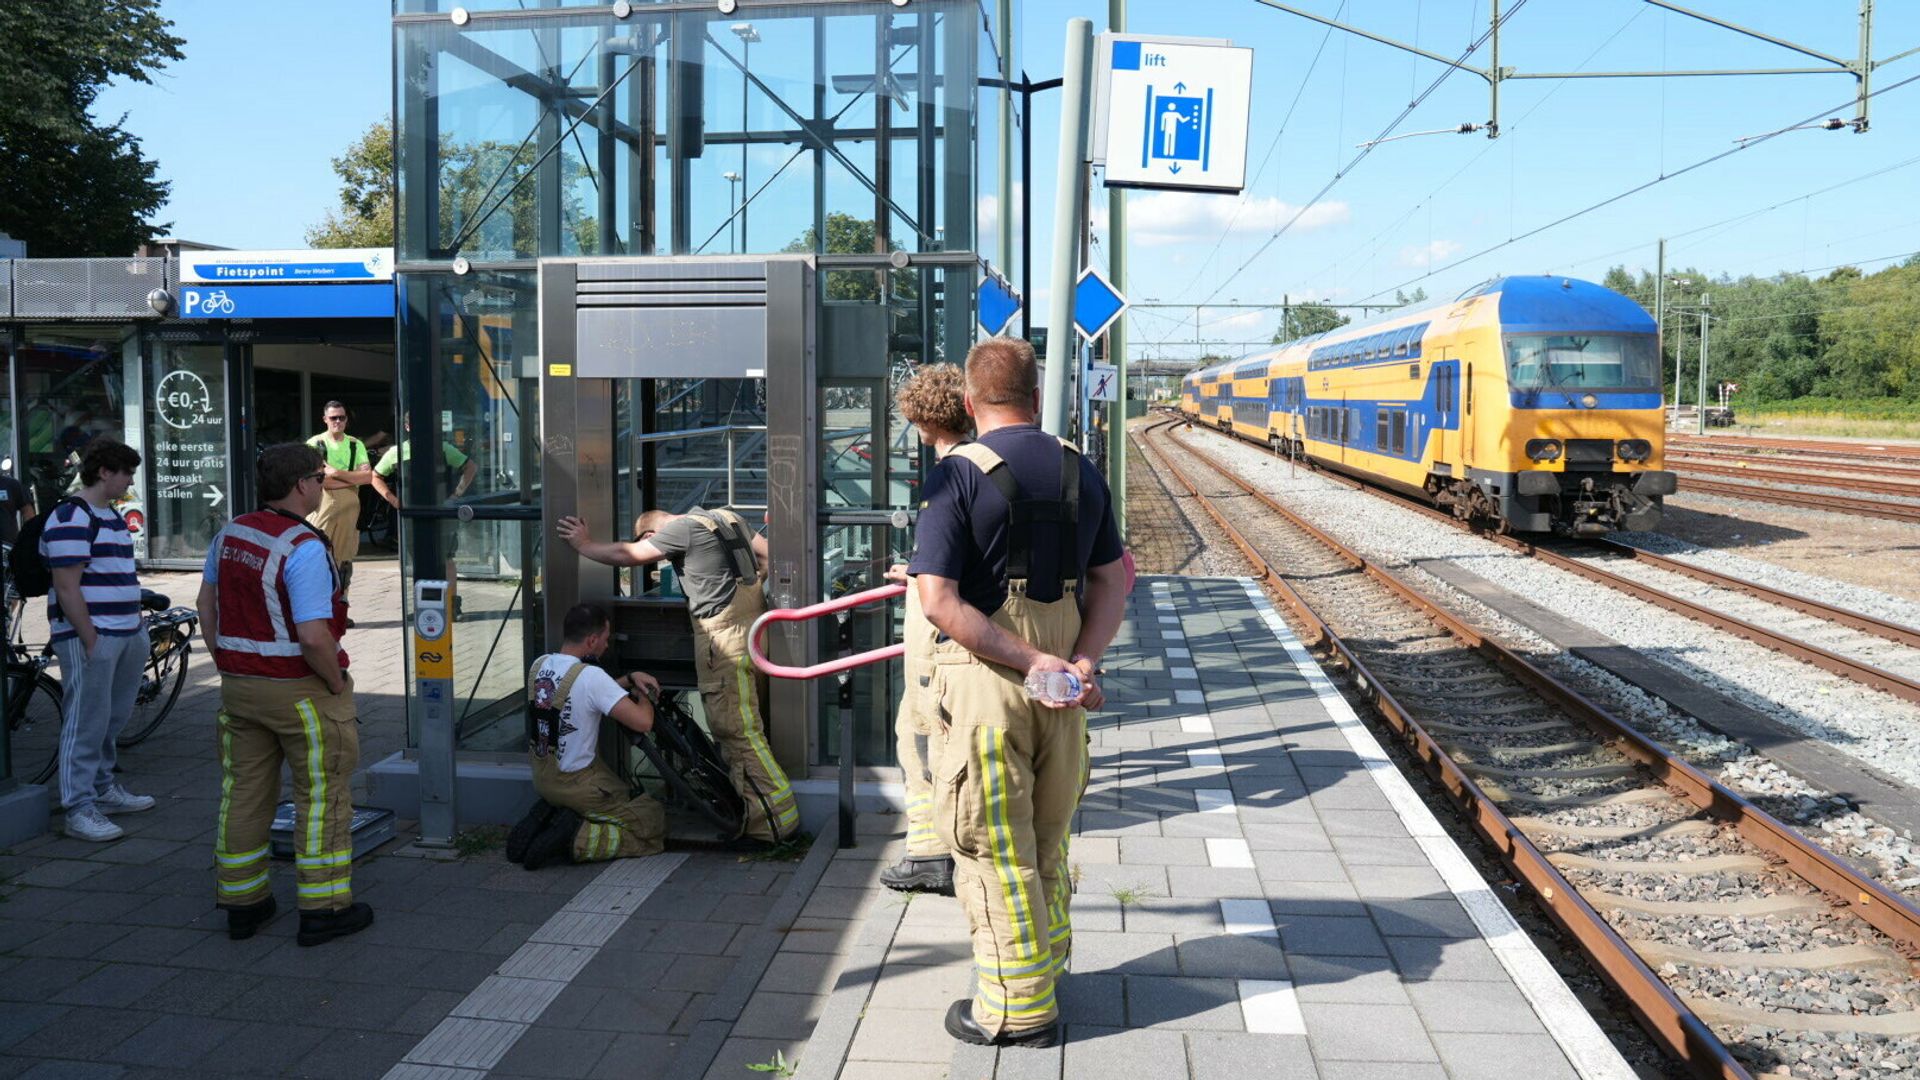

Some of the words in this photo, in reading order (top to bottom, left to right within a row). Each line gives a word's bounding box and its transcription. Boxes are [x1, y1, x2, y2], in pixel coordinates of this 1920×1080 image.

[1145, 53, 1166, 67] lift
[216, 266, 284, 278] Fietspoint
[185, 291, 200, 314] P
[168, 392, 199, 410] €0,-
[192, 414, 204, 425] 24
[206, 416, 222, 425] uur
[156, 441, 178, 452] elke
[180, 443, 214, 452] eerste
[156, 457, 169, 468] 24
[172, 459, 190, 468] uur
[193, 458, 225, 470] gratis
[157, 472, 203, 483] bewaakt
[157, 488, 193, 499] stallen
